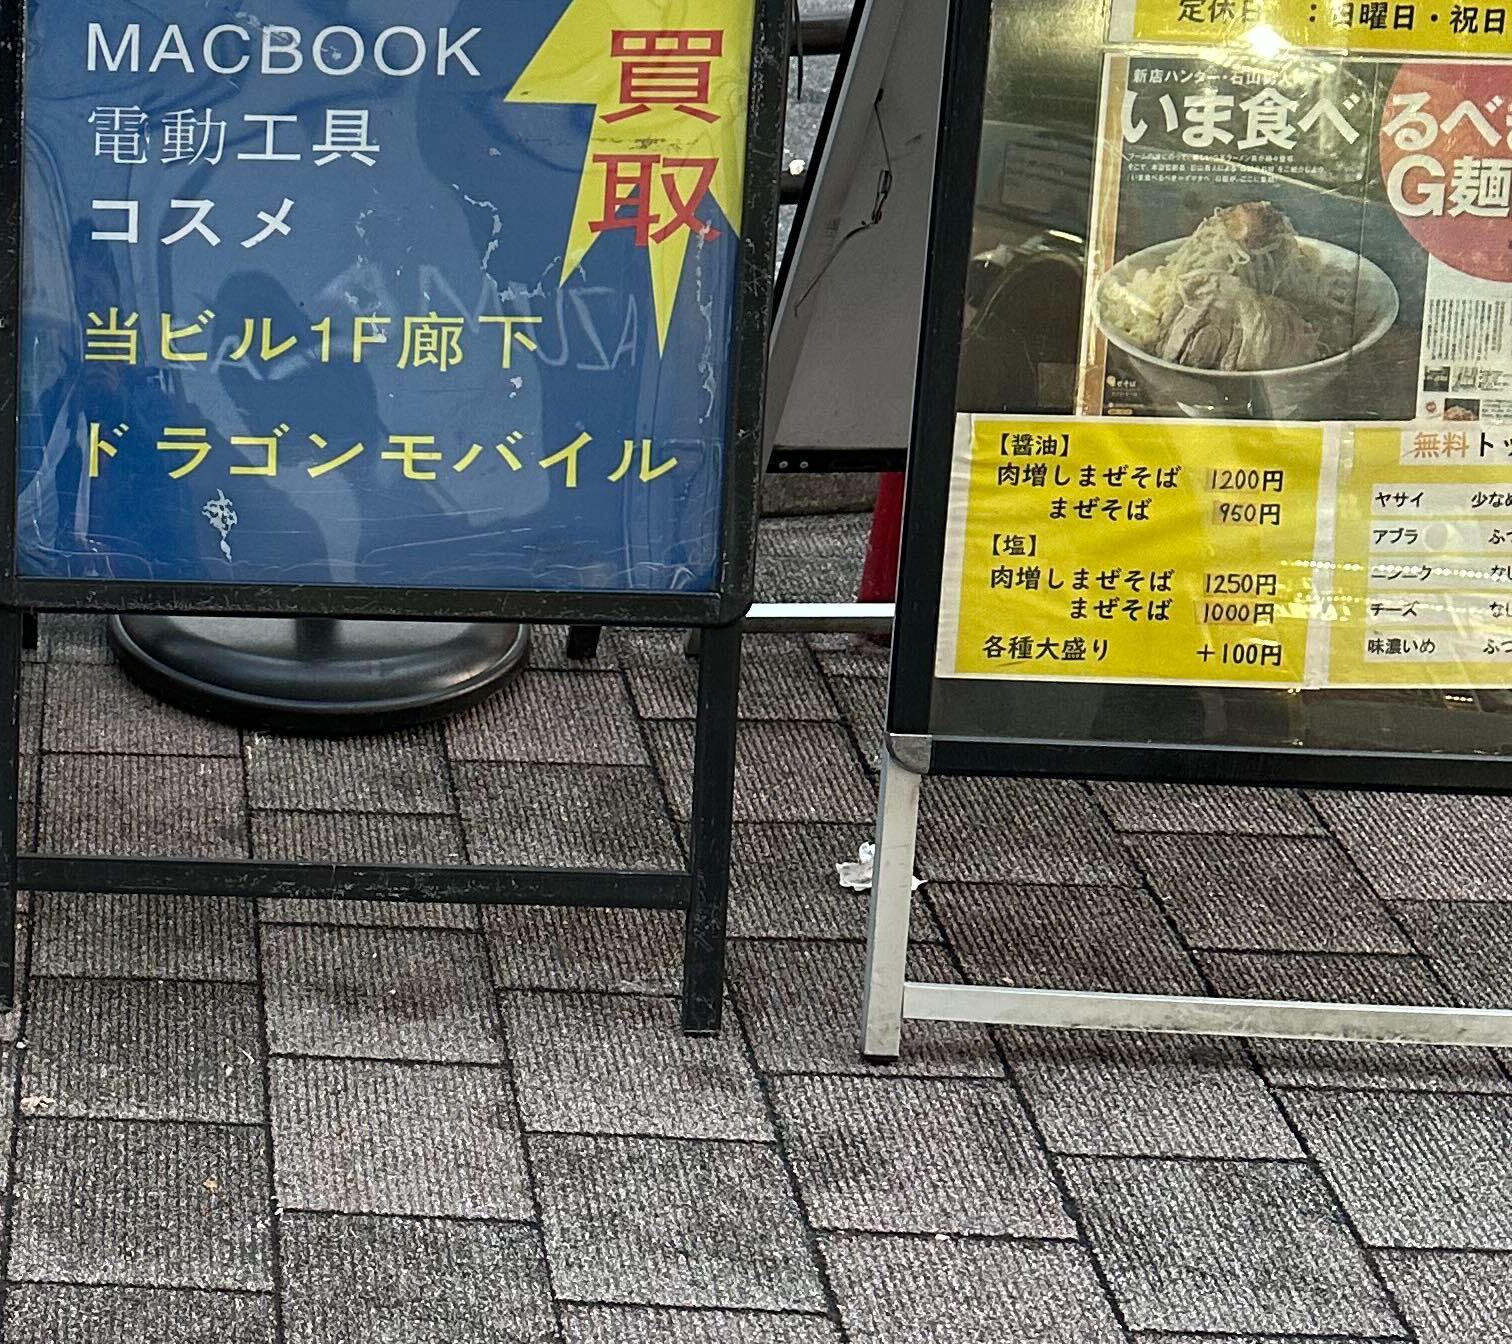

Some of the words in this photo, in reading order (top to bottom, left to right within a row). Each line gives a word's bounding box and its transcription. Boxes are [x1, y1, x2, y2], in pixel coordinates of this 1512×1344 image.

[86, 23, 483, 77] MACBOOK
[88, 105, 381, 167] 電動工具
[90, 197, 295, 249] コスメ
[84, 307, 545, 373] 当ビル1F廊下
[88, 421, 680, 489] ドラゴンモバイル
[998, 433, 1070, 458] 【醤油】
[997, 462, 1183, 489] 肉増しまぜそば
[1209, 469, 1285, 493] 1200円
[1049, 497, 1153, 522] まぜそば
[1219, 503, 1282, 526] 950円
[1374, 491, 1425, 508] ヤサイ
[990, 533, 1038, 557] 【塩】
[1372, 528, 1419, 545] アブラ
[990, 568, 1175, 592] 肉増しまぜそば
[1204, 573, 1278, 596] 1250円
[1069, 596, 1174, 622] まぜそば
[1203, 602, 1275, 625] 1000円
[982, 634, 1110, 661] 各種大盛り
[1368, 638, 1436, 655] 味濃いめ
